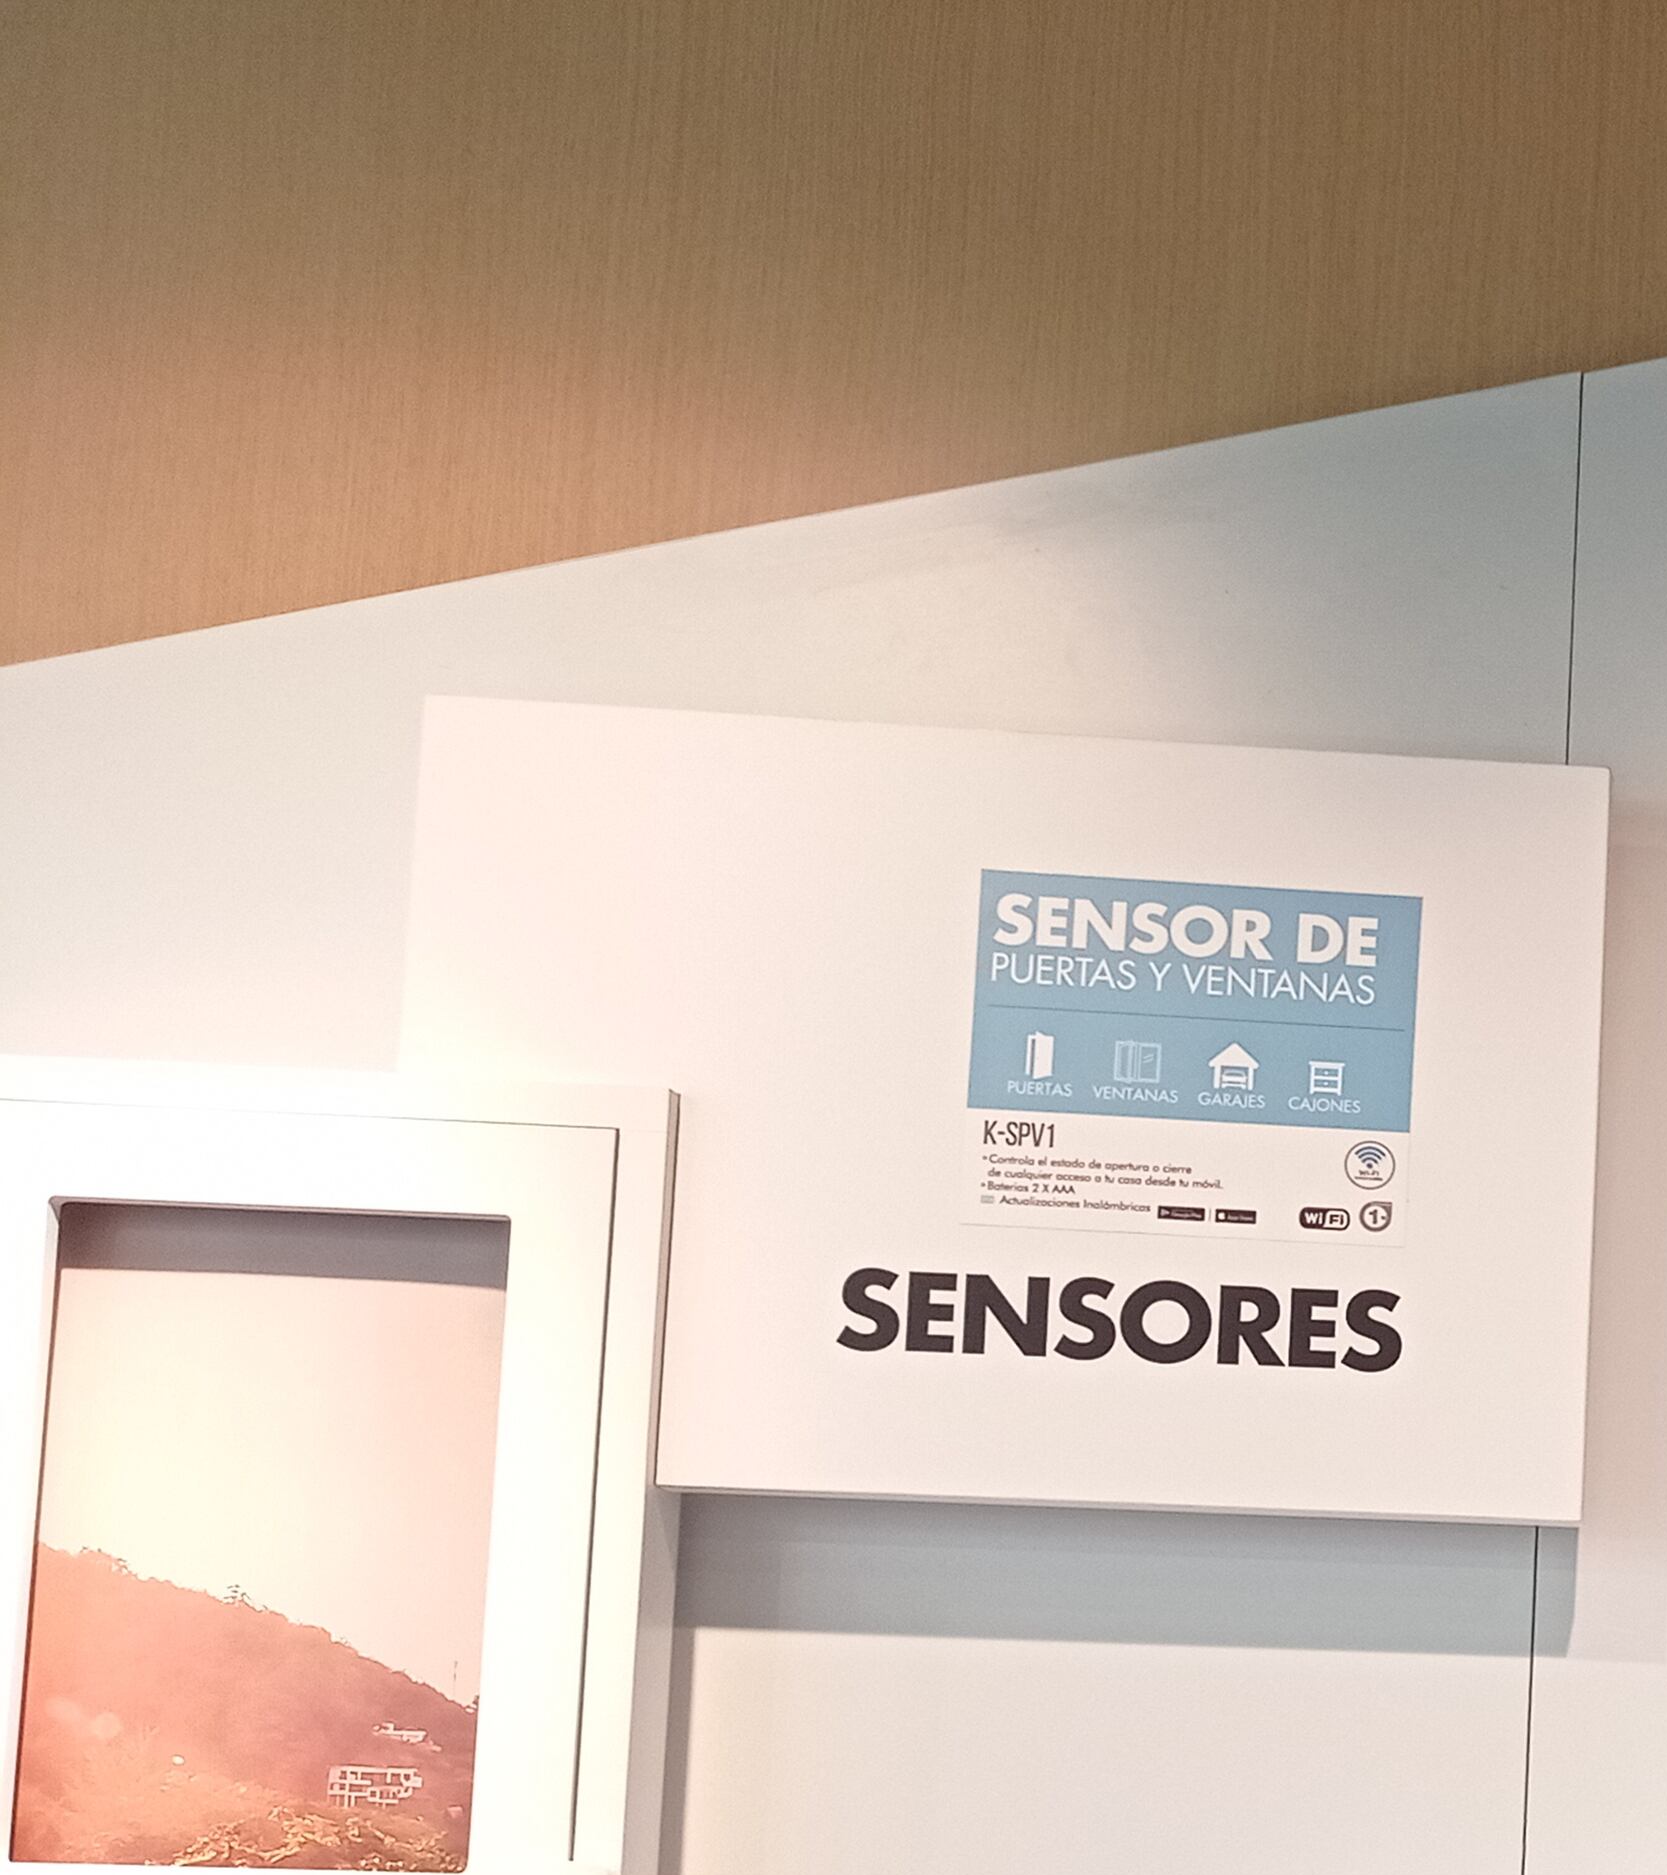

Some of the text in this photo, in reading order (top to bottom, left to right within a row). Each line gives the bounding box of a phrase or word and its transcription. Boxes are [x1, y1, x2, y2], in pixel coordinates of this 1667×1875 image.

[992, 892, 1380, 967] SENSOR DE
[990, 952, 1376, 1006] PUERTAS Y VENTANAS
[1007, 1080, 1361, 1114] PUERTAS VENTANAS GARAJES CAJONES
[983, 1120, 1055, 1148] K-SPV1
[987, 1167, 1001, 1178] de
[1004, 1168, 1053, 1183] cualquier
[1056, 1172, 1091, 1183] acceso
[1118, 1176, 1142, 1186] casa
[1145, 1175, 1176, 1188] desde
[1178, 1177, 1189, 1188] tu
[988, 1154, 1035, 1166] Controla
[1038, 1156, 1047, 1166] el
[1050, 1158, 1085, 1169] estado
[1088, 1159, 1102, 1170] de
[1105, 1161, 1149, 1174] apertura
[1162, 1163, 1192, 1175] cierre
[1052, 1184, 1075, 1194] AAA
[835, 1266, 1403, 1373] SENSORES
